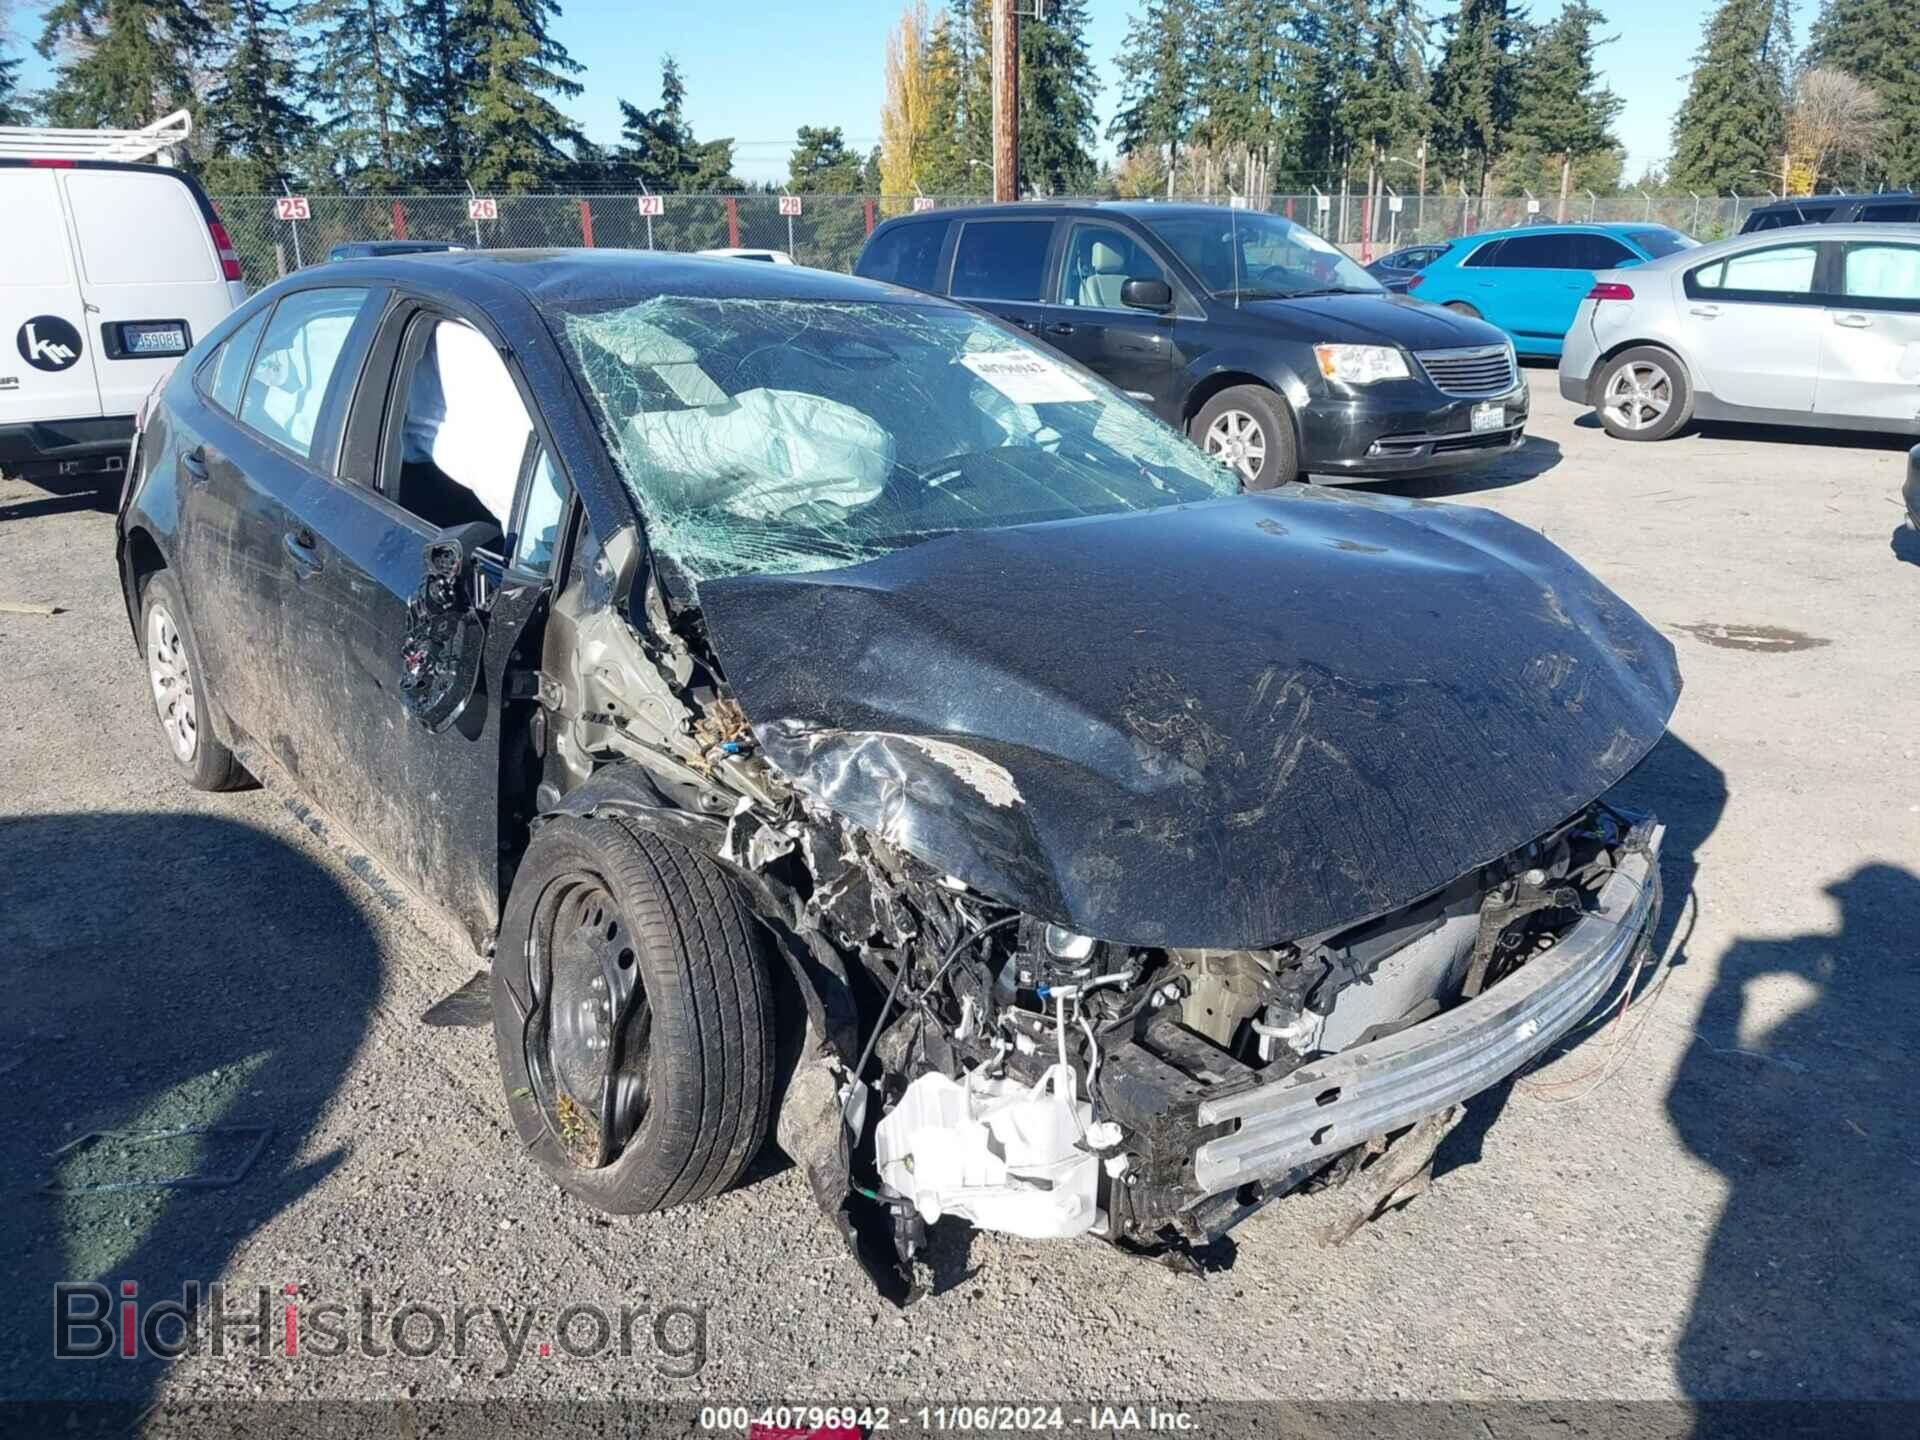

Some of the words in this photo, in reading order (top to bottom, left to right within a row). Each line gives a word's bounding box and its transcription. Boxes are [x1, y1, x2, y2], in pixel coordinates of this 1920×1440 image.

[280, 200, 306, 218] 25
[472, 200, 494, 217] 26
[642, 198, 659, 214] 27
[782, 198, 799, 213] 28
